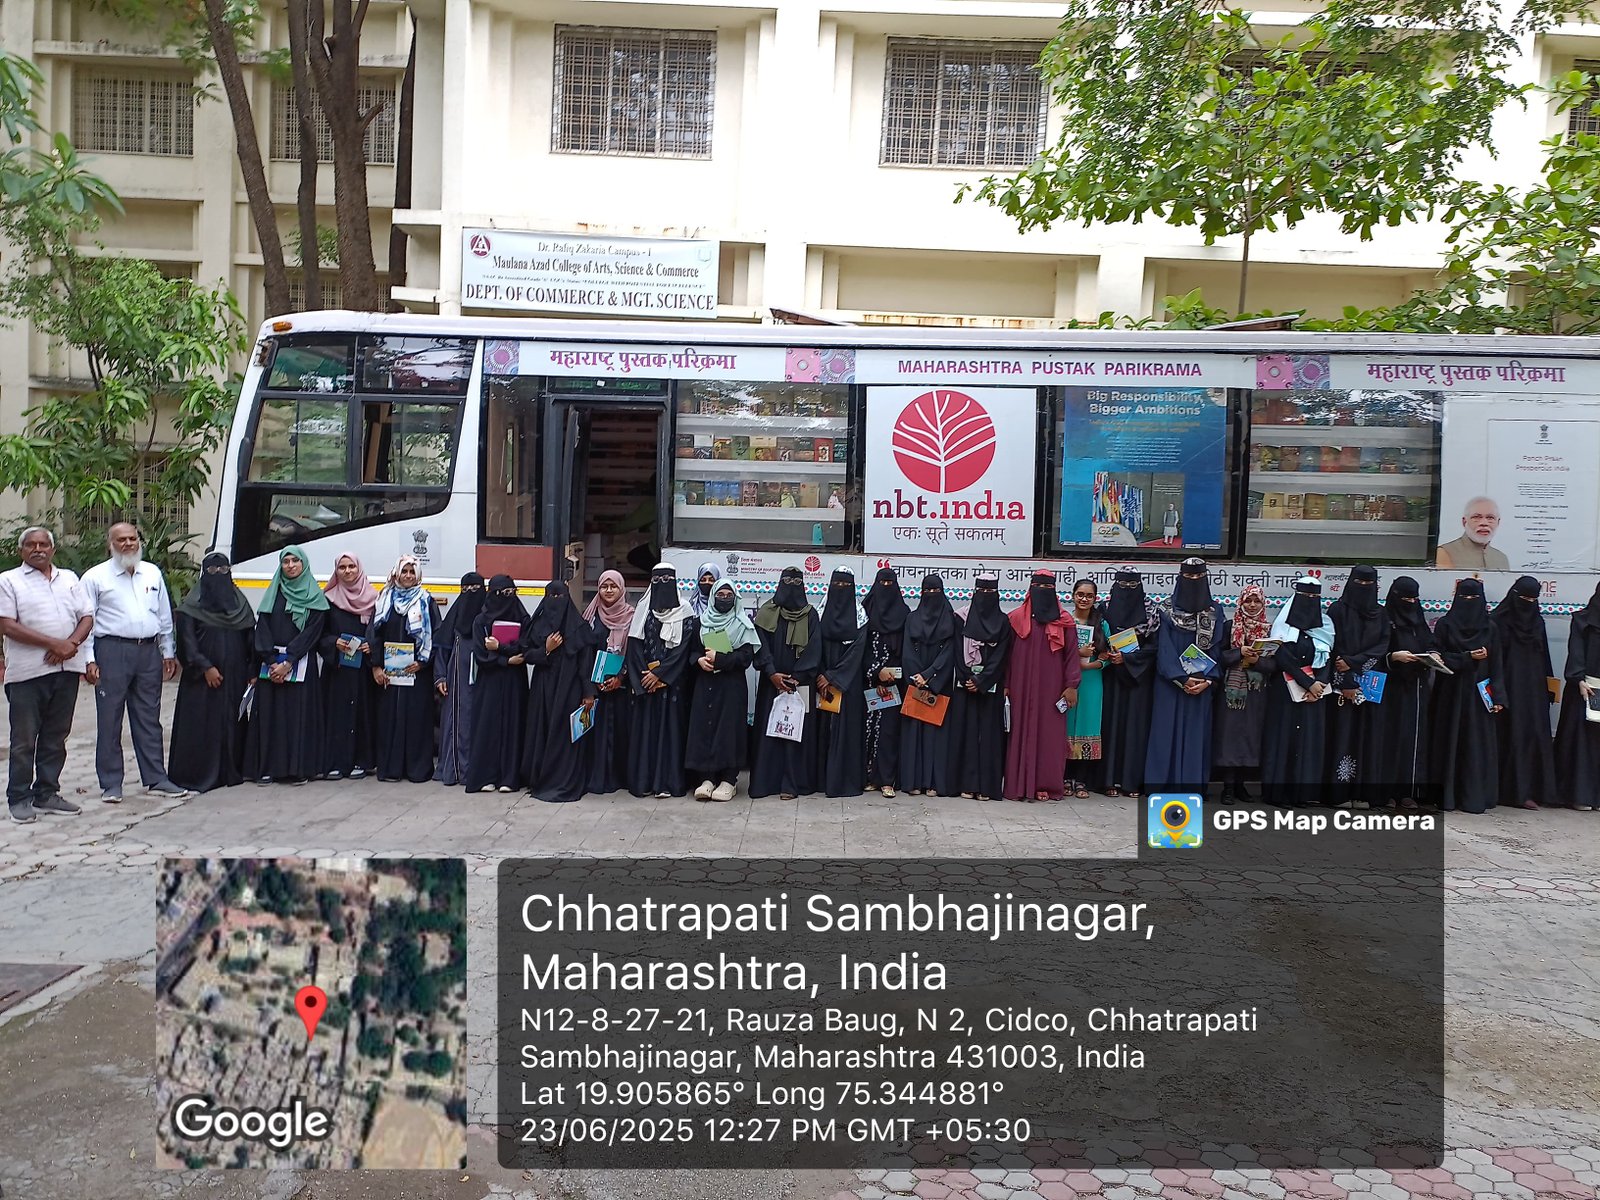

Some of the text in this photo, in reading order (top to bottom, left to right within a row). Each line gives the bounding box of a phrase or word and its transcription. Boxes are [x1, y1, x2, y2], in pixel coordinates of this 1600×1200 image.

[538, 241, 550, 252] Dr.
[576, 243, 606, 255] Zakaria
[608, 245, 640, 258] Campus
[493, 255, 700, 278] Maulana Azad College of Arts, Science & Commerce
[466, 283, 502, 300] DEPT.
[505, 285, 524, 302] OF
[526, 286, 605, 306] COMMERCE
[607, 290, 618, 307] &
[621, 292, 654, 308] MGT.
[656, 293, 715, 311] SCIENCE
[550, 349, 738, 373] महाराष्ट्र पुस्तक परिक्रमा
[898, 359, 1202, 377] MAHARASHTRA PUSTAK PARIKRAMA
[1367, 361, 1566, 387] महाराष्ट्र पुस्तक परिक्रमा
[1087, 390, 1205, 404] Big Responsibility,
[1089, 403, 1132, 415] Bigger
[872, 489, 1026, 520] nbt.india
